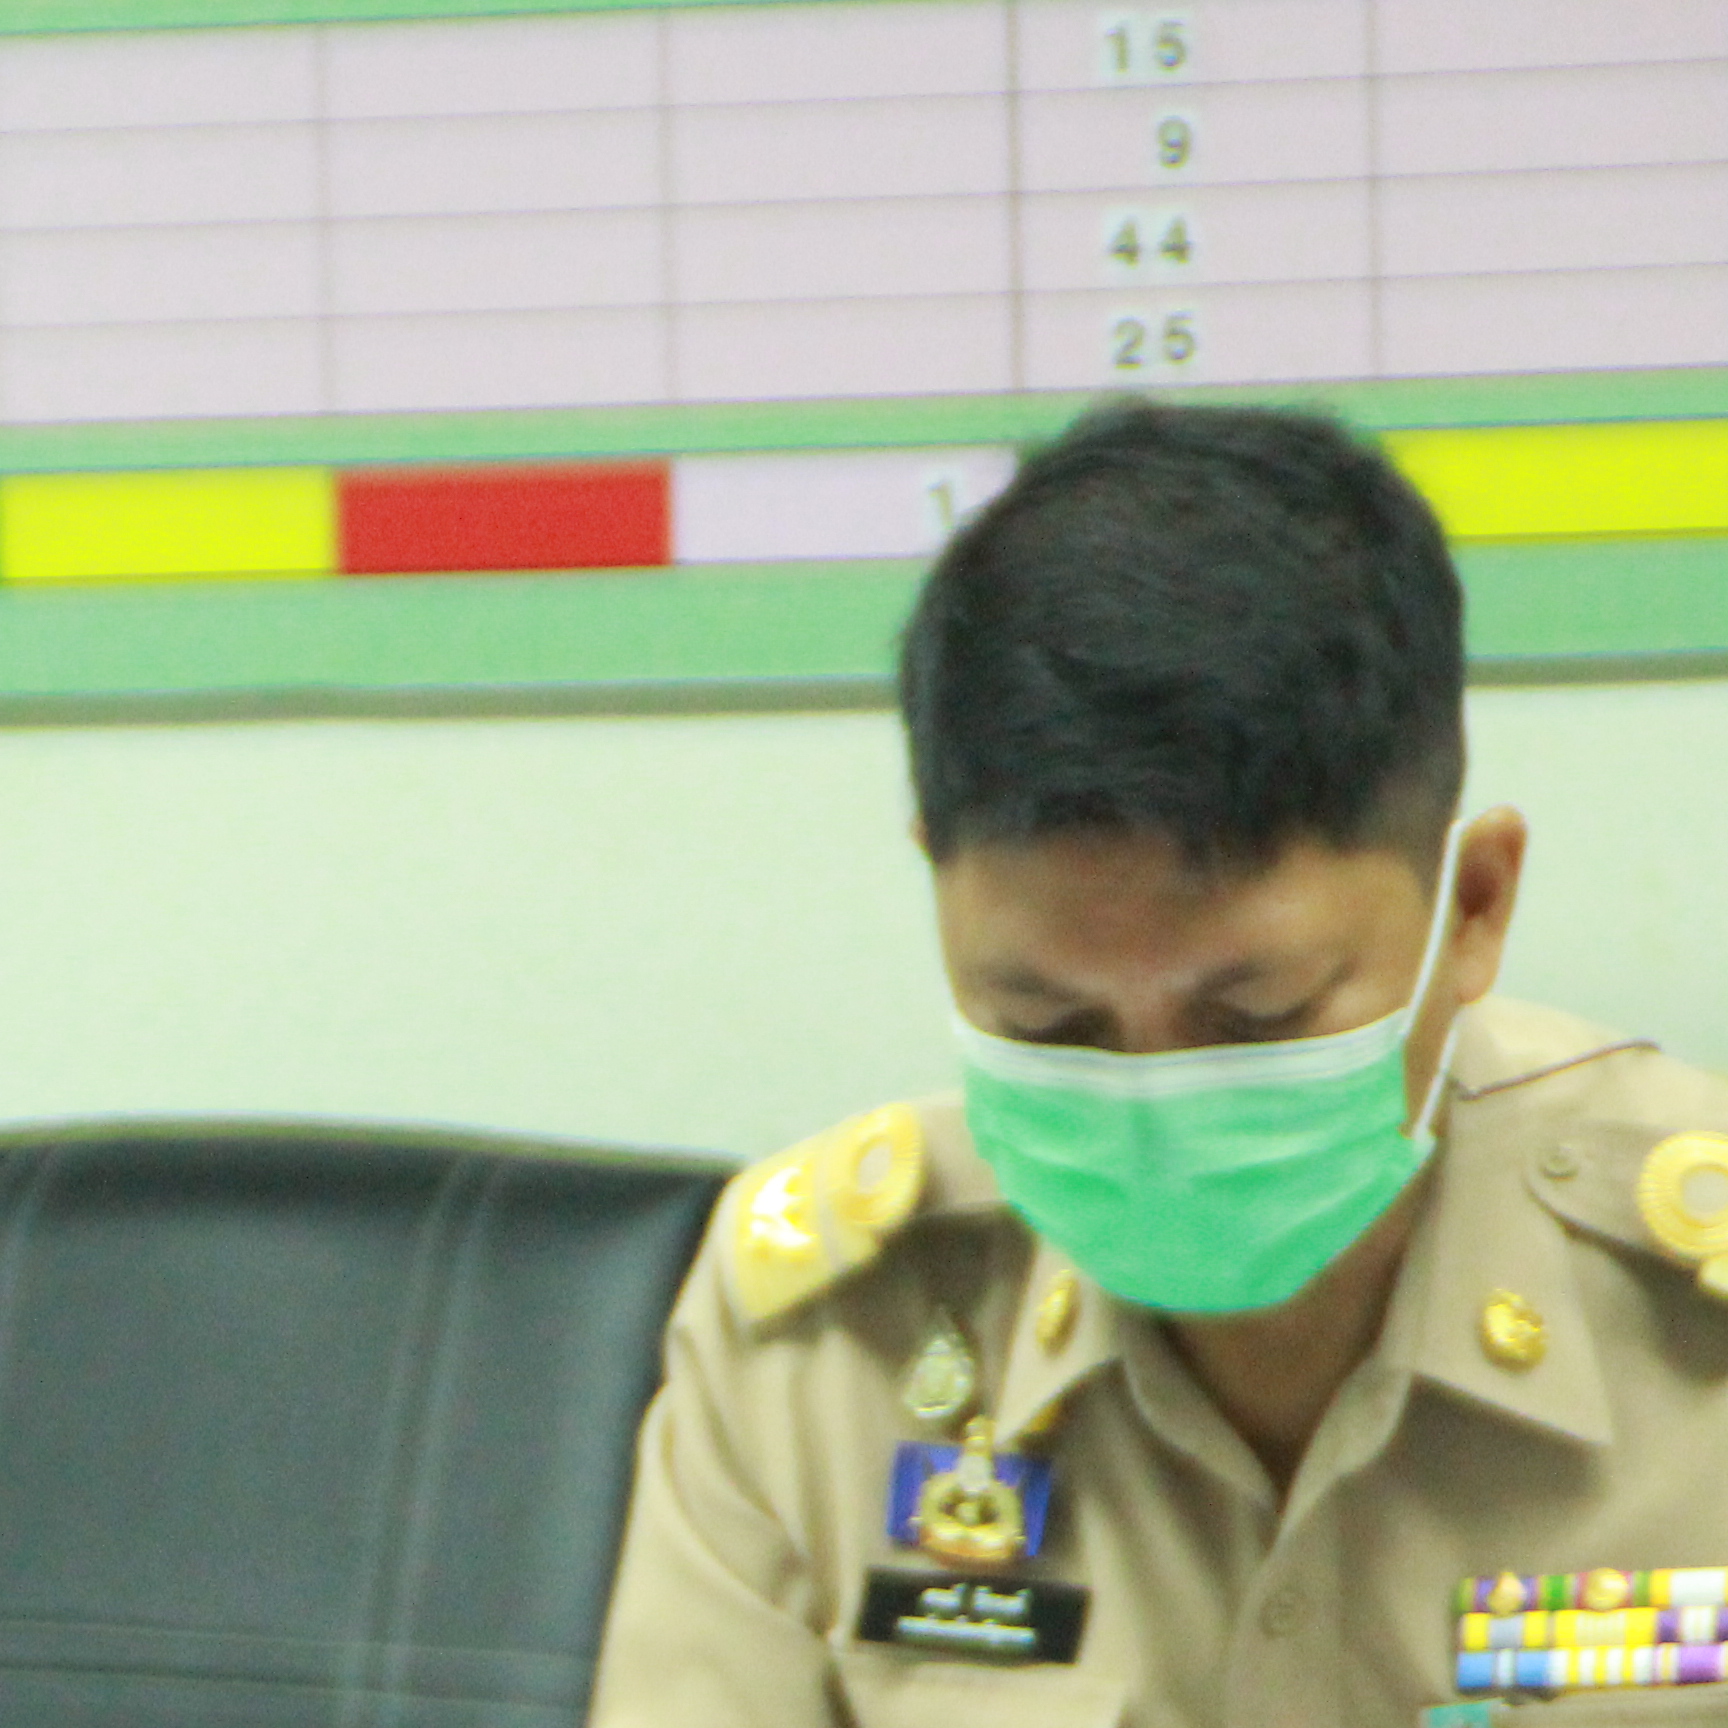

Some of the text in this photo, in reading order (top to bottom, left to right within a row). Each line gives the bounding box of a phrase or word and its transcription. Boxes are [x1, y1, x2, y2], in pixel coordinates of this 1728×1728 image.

[1104, 18, 1189, 74] 15
[1155, 115, 1194, 170] 9
[1107, 213, 1194, 268] 44
[1111, 310, 1196, 371] 25
